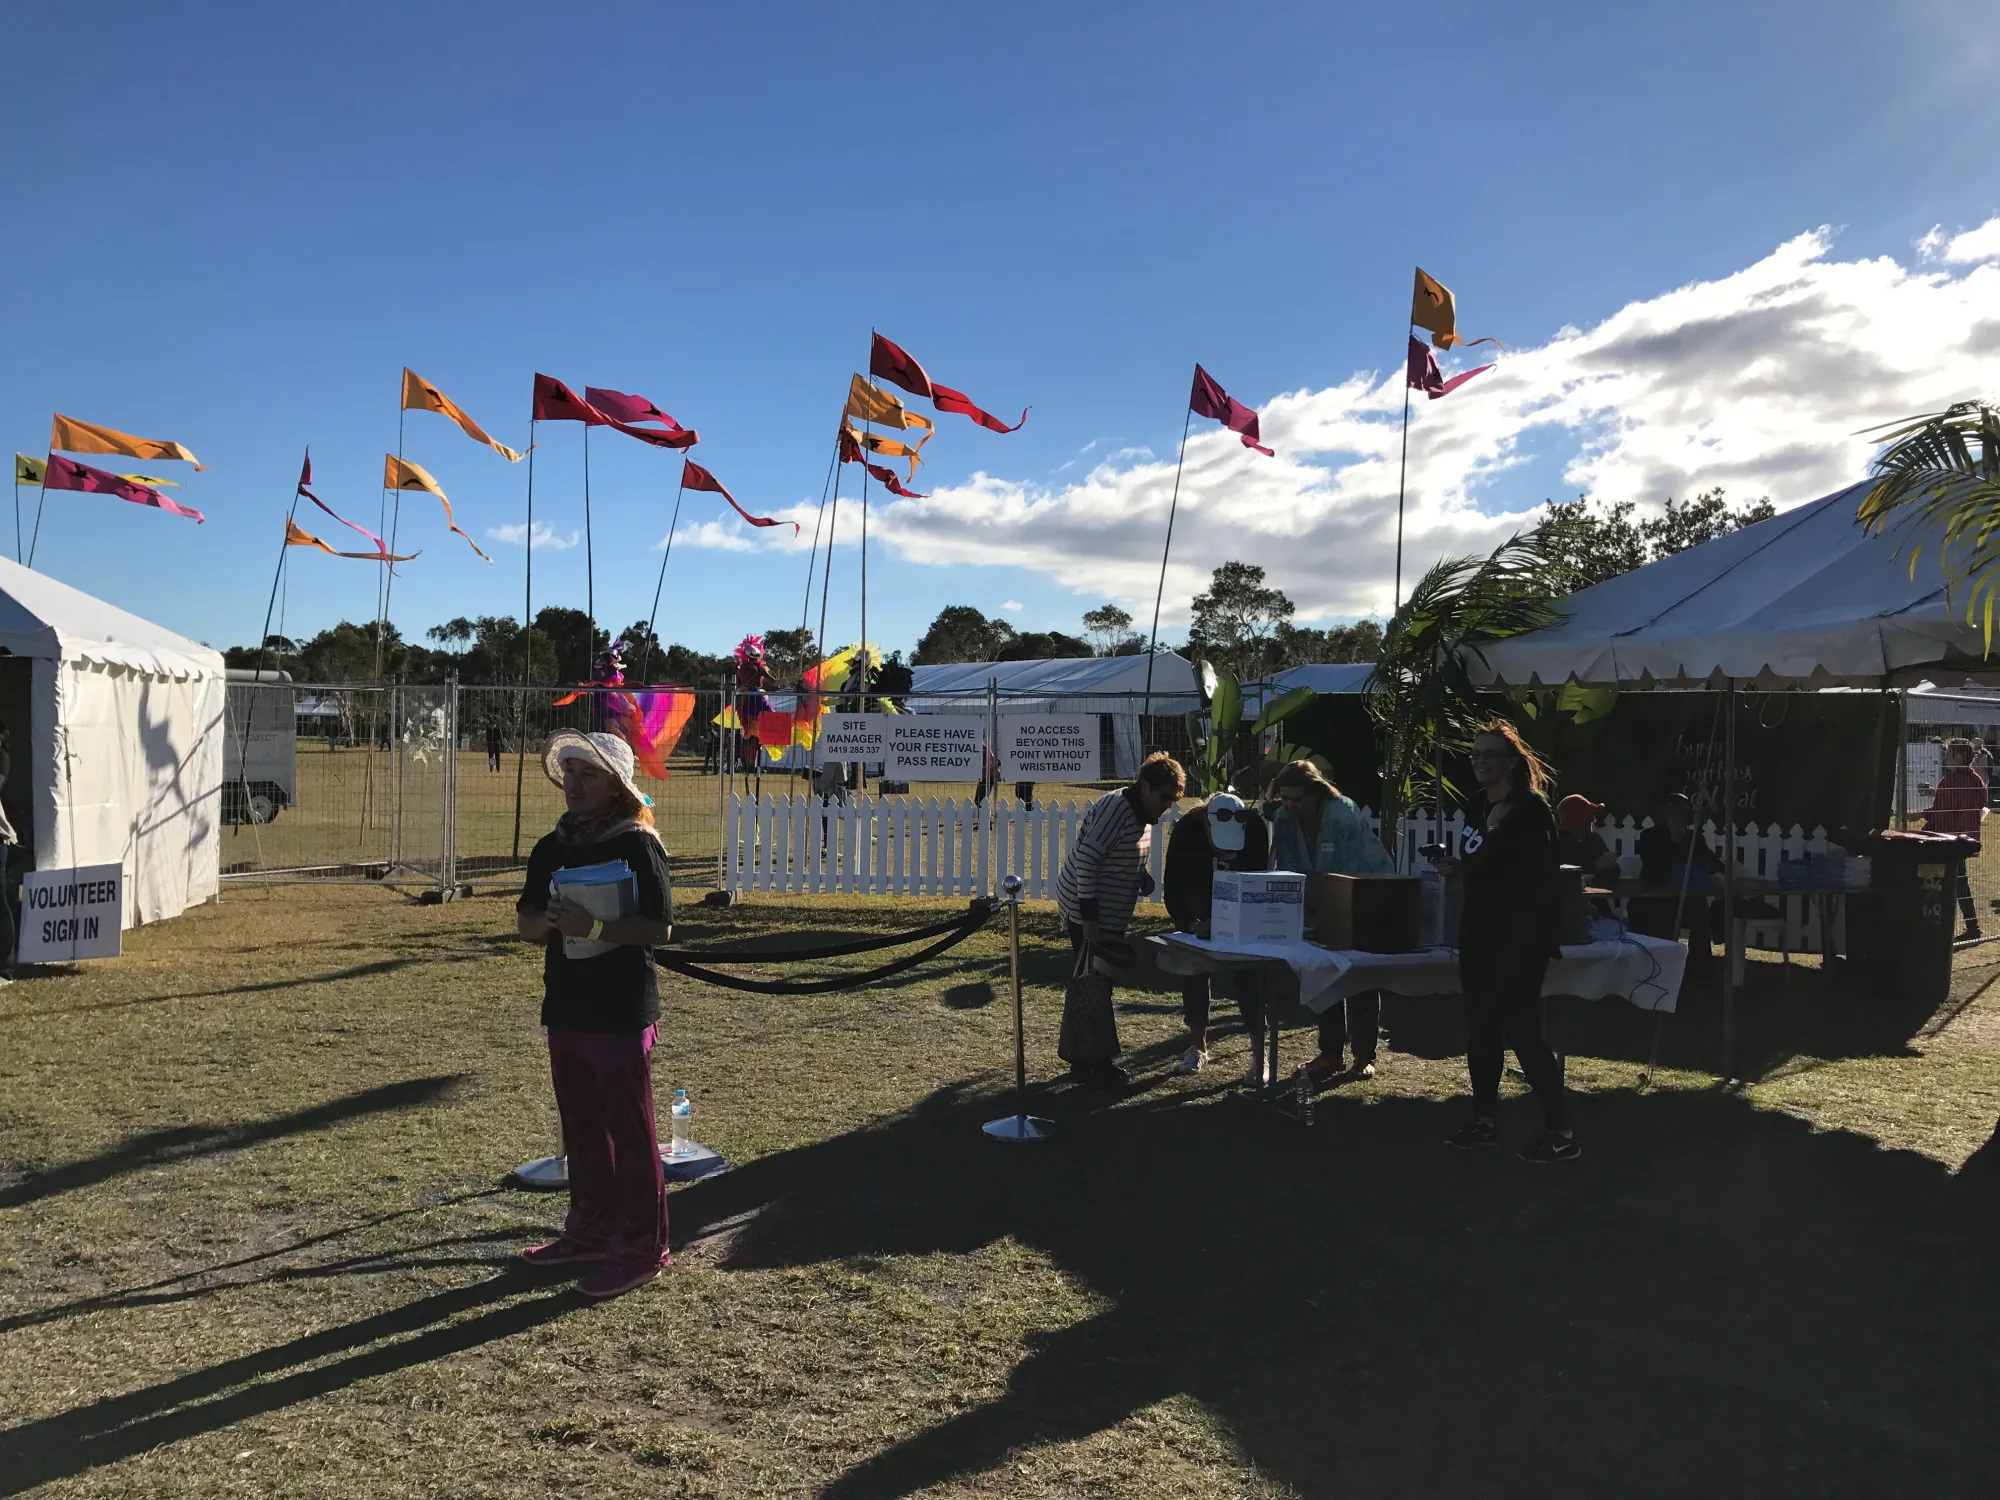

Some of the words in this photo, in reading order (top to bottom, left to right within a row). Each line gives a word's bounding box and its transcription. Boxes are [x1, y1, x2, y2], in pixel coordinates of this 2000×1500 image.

[843, 722, 866, 730] SITE
[1021, 726, 1035, 734] NO
[1038, 726, 1080, 735] ACCESS
[896, 729, 940, 738] PLEASE
[945, 729, 974, 738] HAVE
[827, 735, 882, 743] MANAGER
[1016, 738, 1058, 746] BEYOND
[1062, 738, 1084, 746] THIS
[828, 745, 848, 754] 0419
[849, 746, 864, 754] 285
[865, 746, 881, 754] 337
[889, 742, 921, 751] YOUR
[925, 743, 979, 753] FESTIVAL
[1010, 750, 1042, 759] POINT
[1043, 750, 1091, 759] WITHOUT
[898, 757, 927, 766] PASS
[931, 757, 970, 766] READY
[1019, 762, 1082, 772] WRISTBAND
[28, 880, 116, 910] VOLUNTEER
[42, 917, 79, 943] SIGN
[83, 916, 99, 940] IN
